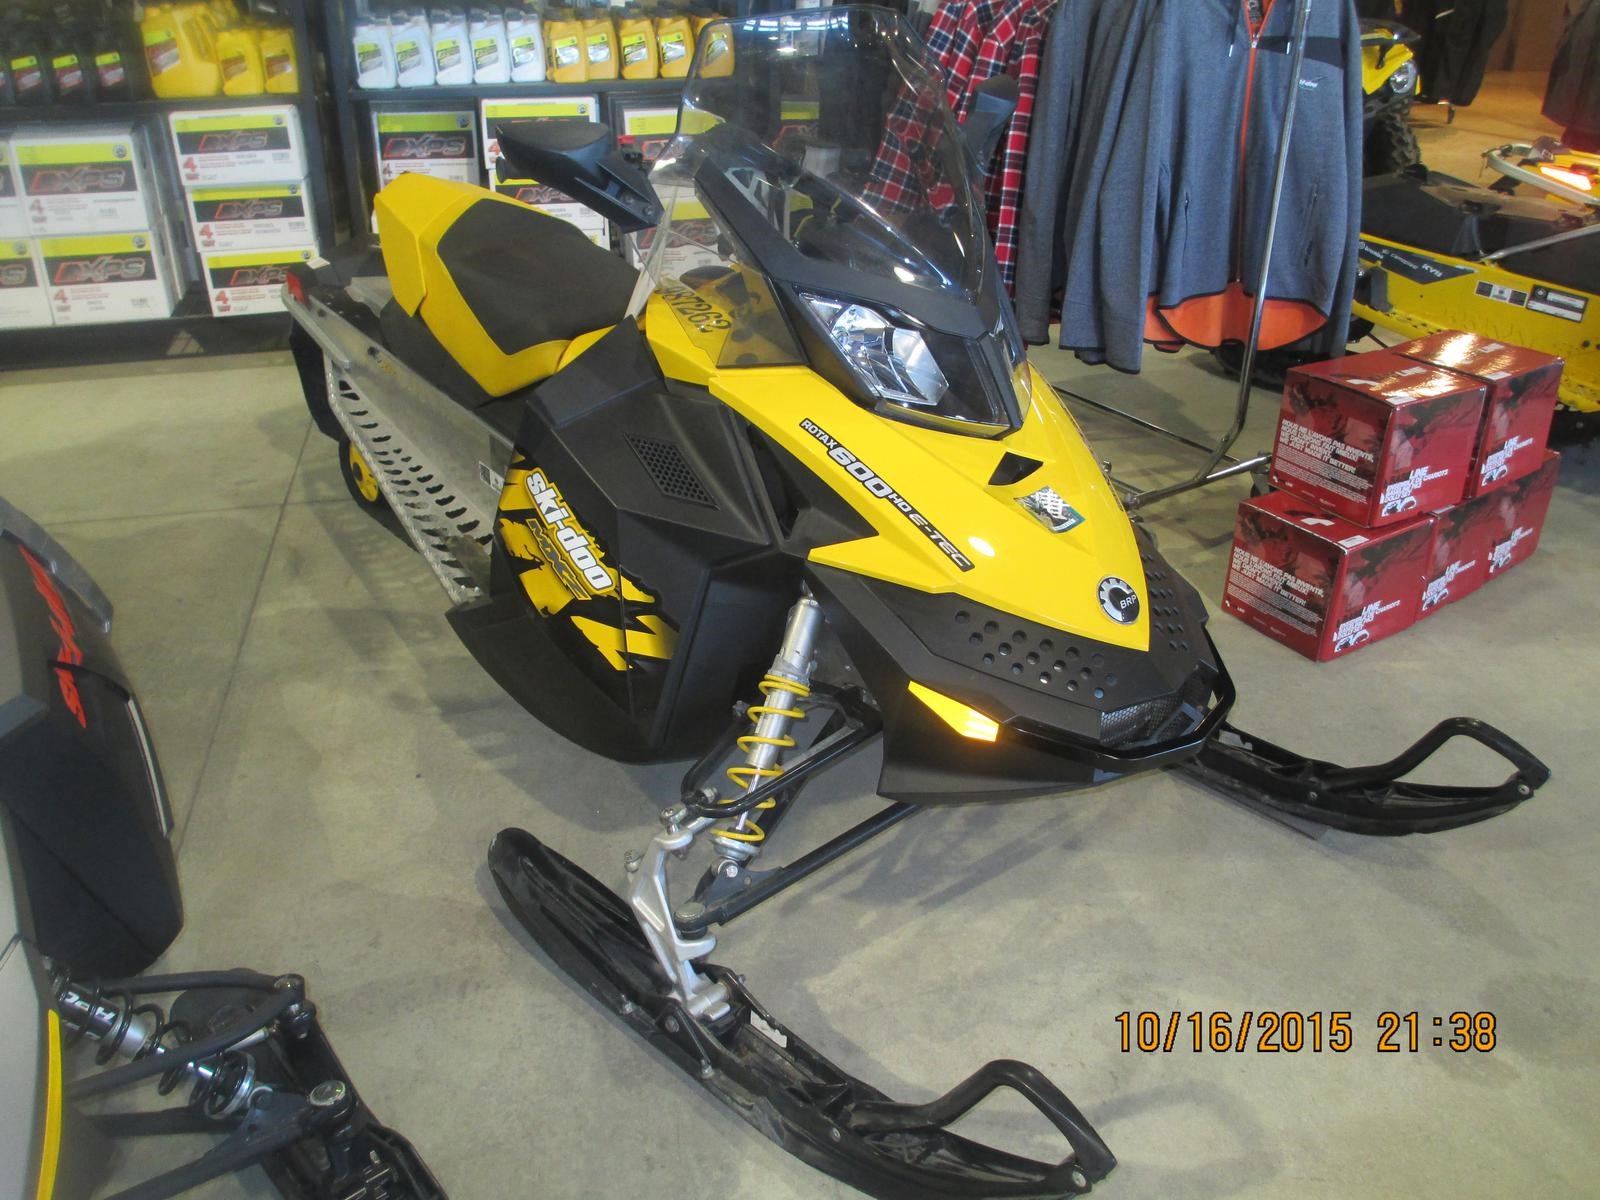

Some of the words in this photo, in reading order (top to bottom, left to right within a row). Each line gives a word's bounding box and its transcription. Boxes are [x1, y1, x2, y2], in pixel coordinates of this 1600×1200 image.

[801, 420, 838, 450] ROTAX
[828, 446, 894, 498] 600
[909, 513, 972, 567] E-TEC
[1410, 466, 1430, 479] LINE
[526, 472, 613, 590] ski-doo
[1119, 594, 1138, 610] BRP
